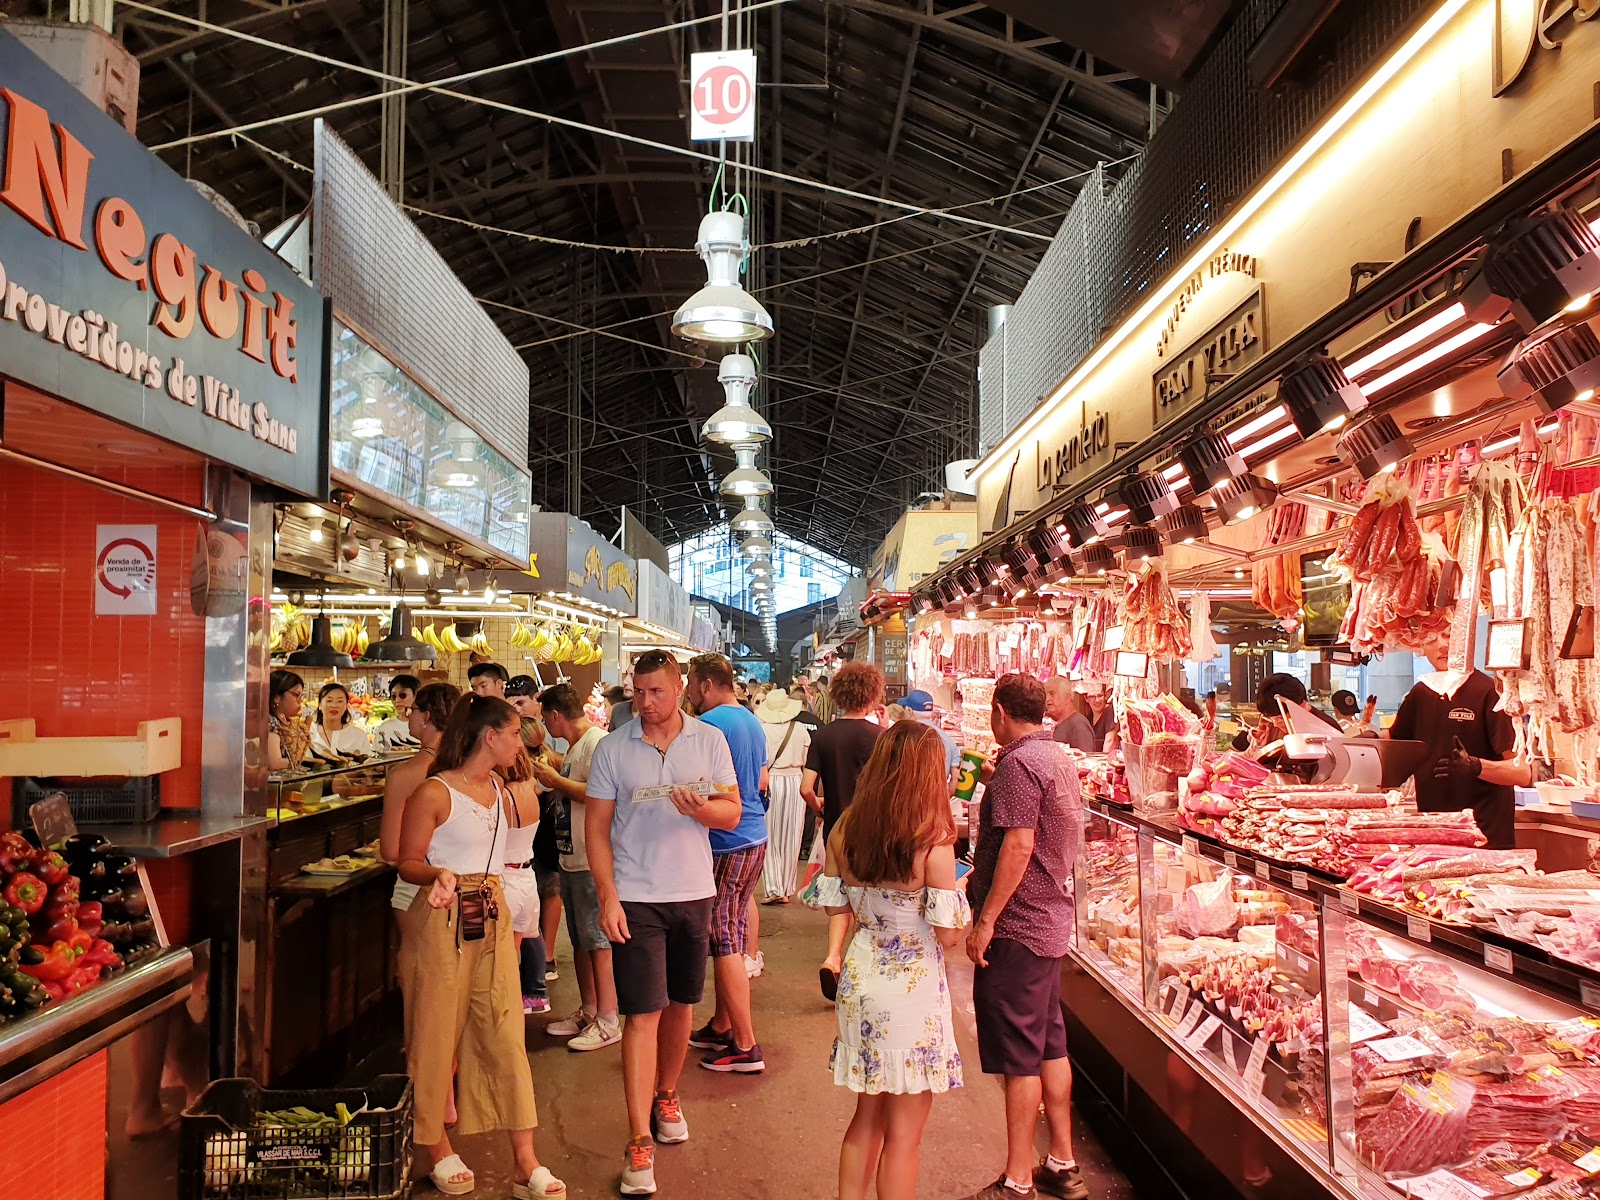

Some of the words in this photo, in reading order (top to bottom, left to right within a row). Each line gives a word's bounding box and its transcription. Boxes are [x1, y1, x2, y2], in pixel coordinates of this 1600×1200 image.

[698, 73, 748, 117] 10
[0, 86, 297, 384] Neguit
[0, 261, 163, 390] roveïdors
[167, 356, 198, 407] de
[201, 374, 251, 433] Vida
[252, 401, 298, 454] Sana
[1156, 356, 1195, 407] CAN
[1201, 310, 1259, 377] VILA
[1036, 439, 1053, 493] La
[106, 565, 146, 574] proximitat
[283, 1149, 291, 1157] DE
